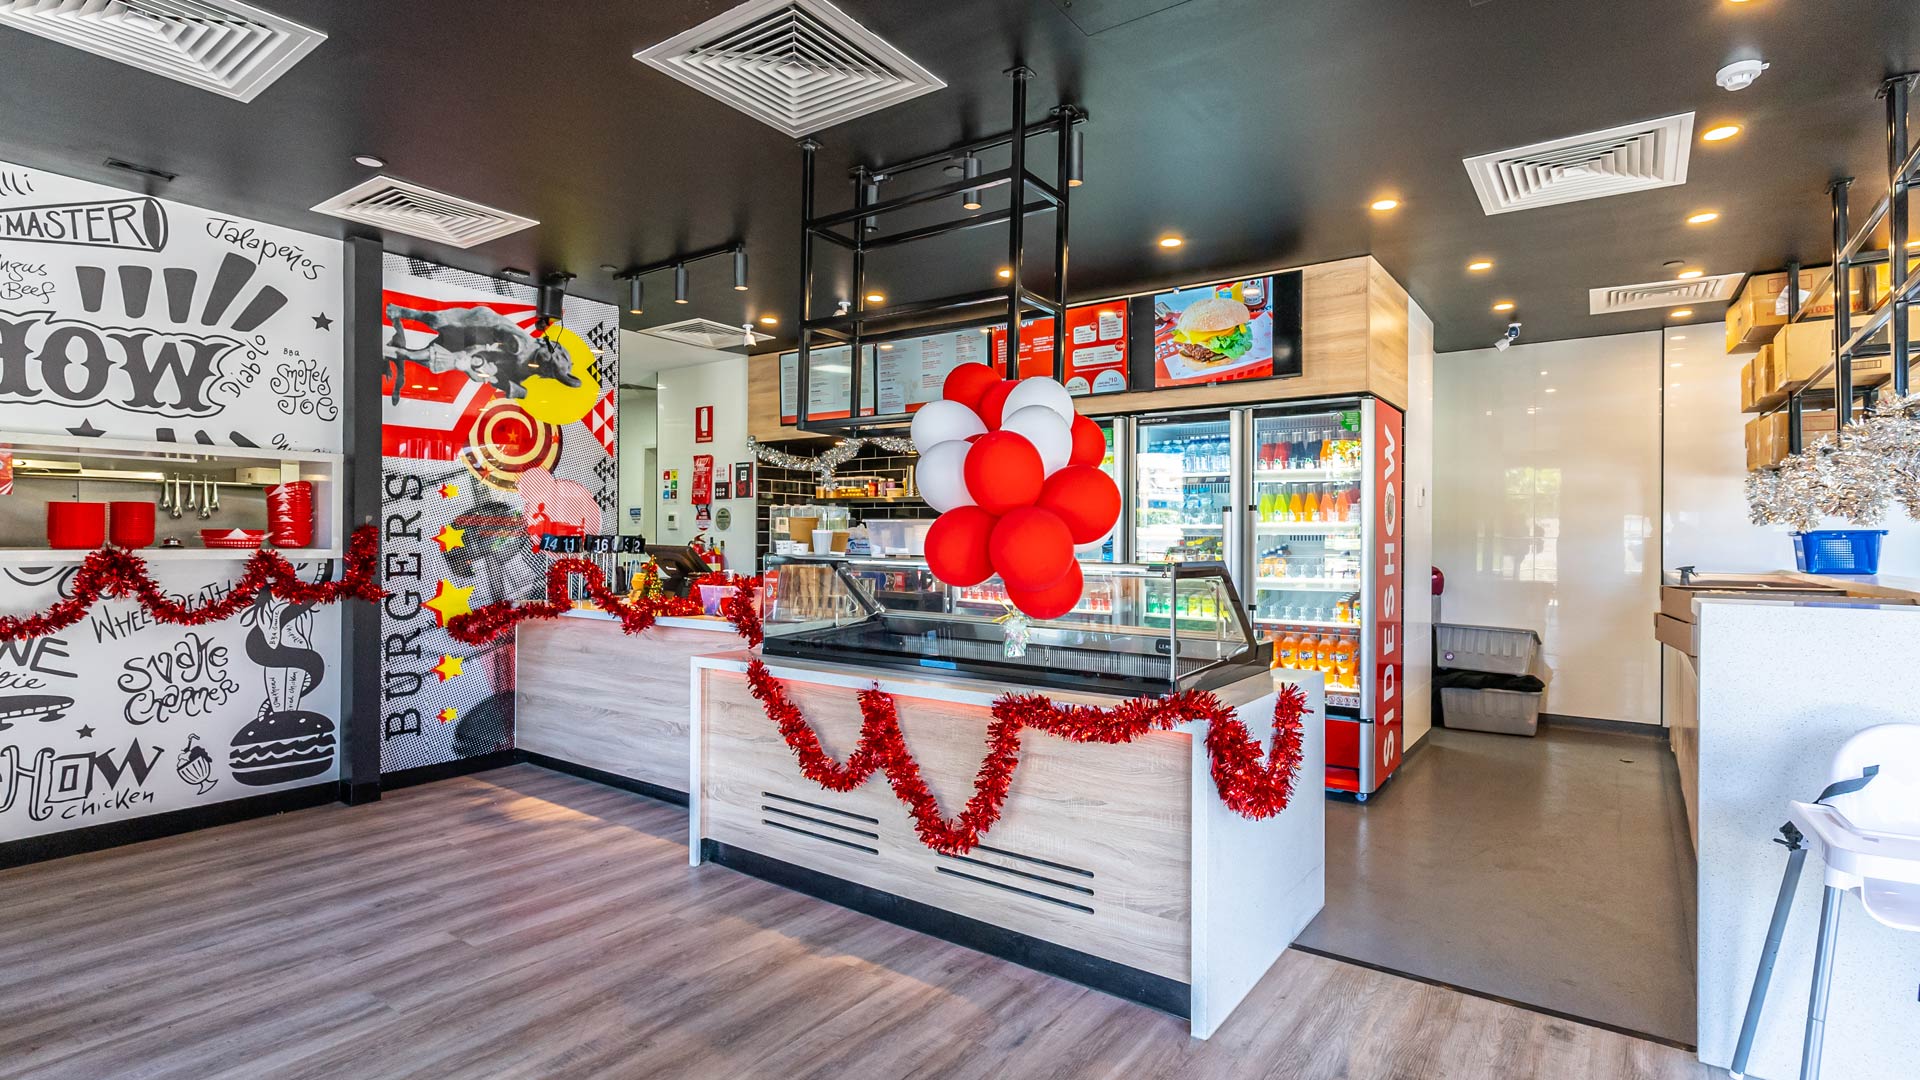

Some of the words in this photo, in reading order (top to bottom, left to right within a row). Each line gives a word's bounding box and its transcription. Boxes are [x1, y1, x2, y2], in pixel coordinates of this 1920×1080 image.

[0, 170, 35, 197] lli
[0, 204, 147, 247] MASTER
[0, 254, 48, 282] ngus
[206, 217, 327, 281] Jalapeños
[0, 281, 57, 304] Beef
[219, 334, 269, 399] Diabolo
[544, 535, 559, 551] 14
[384, 474, 423, 743] BURGERS
[1383, 423, 1396, 768] SIDESHOW
[91, 604, 160, 645] WHEE
[0, 737, 165, 822] HOW
